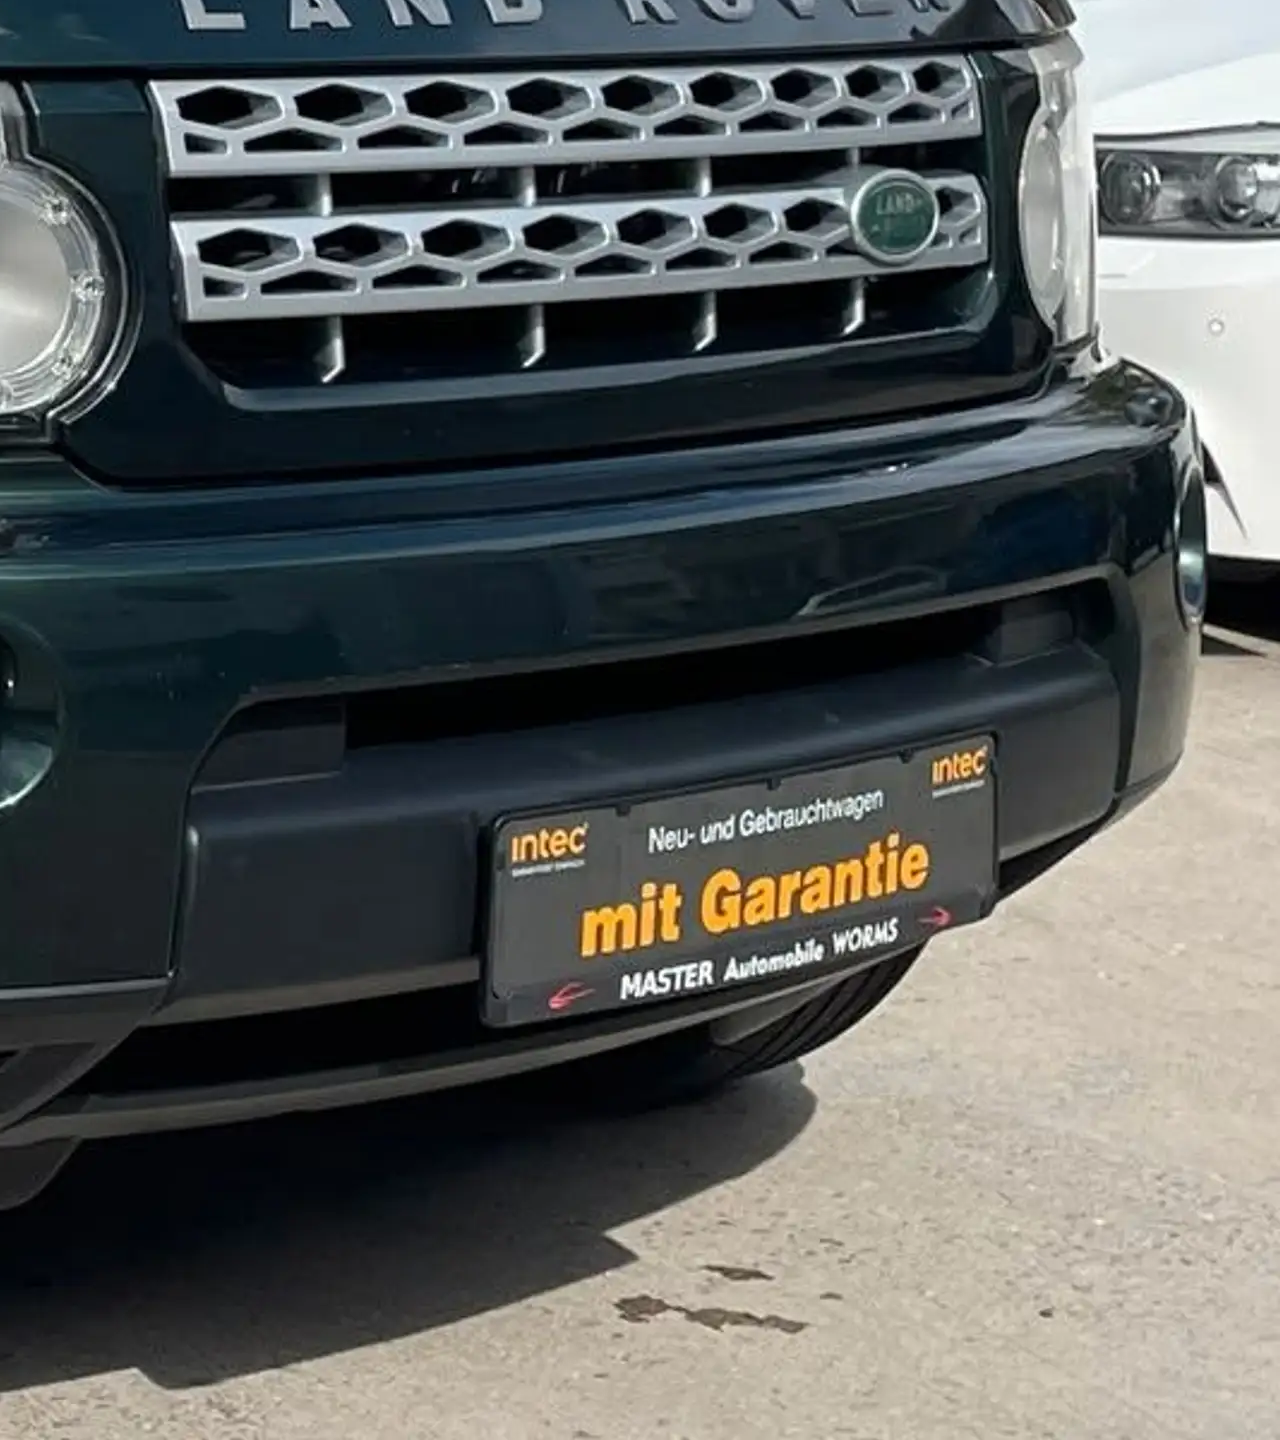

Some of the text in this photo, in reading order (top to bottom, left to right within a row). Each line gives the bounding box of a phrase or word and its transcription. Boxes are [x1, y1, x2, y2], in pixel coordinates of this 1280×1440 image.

[511, 823, 588, 863] intec
[648, 788, 885, 855] Neu- und Gebrauchtwagen
[580, 833, 930, 958] mit Garantie
[620, 917, 900, 1000] MASTER Automobile WORMS
